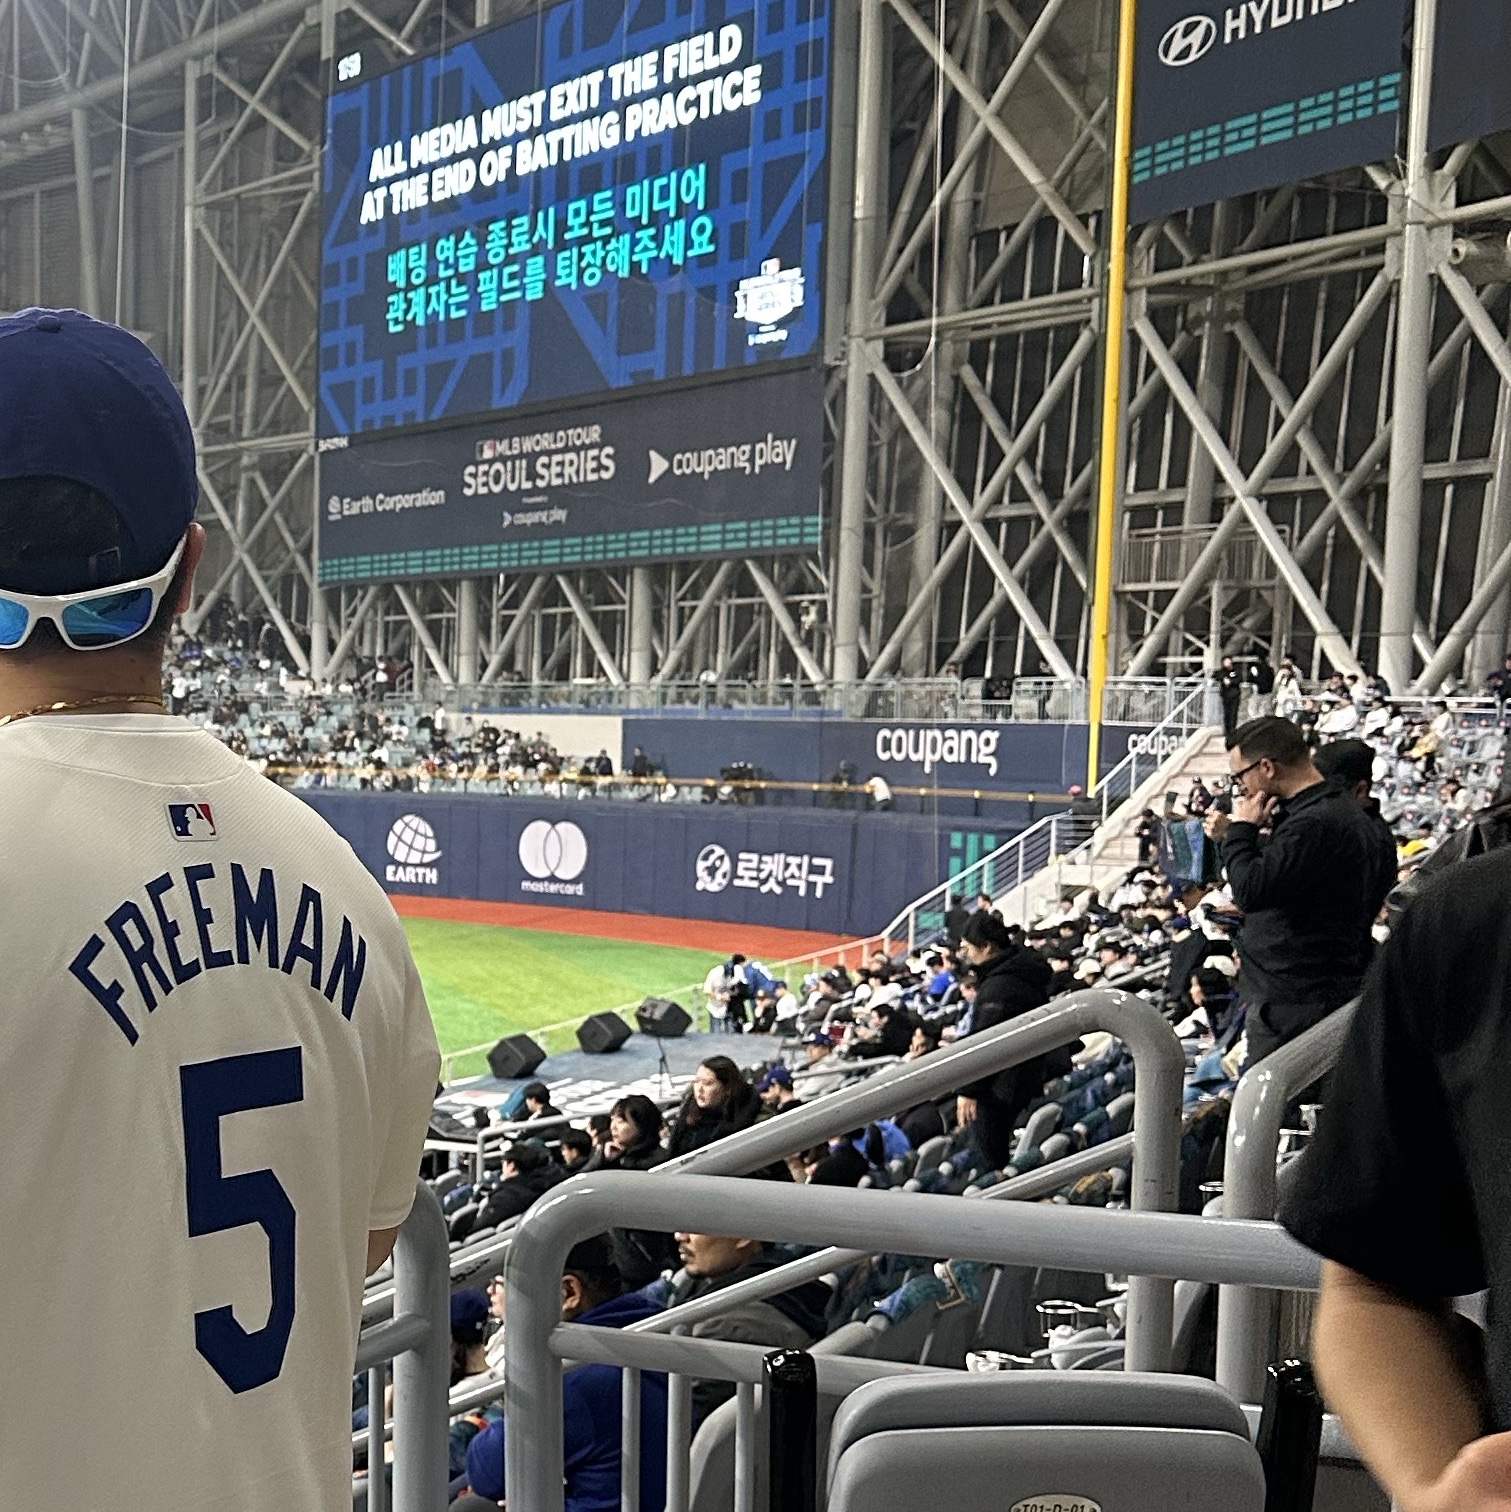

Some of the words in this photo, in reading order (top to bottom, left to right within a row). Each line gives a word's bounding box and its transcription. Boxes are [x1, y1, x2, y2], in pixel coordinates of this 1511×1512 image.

[1223, 0, 1356, 45] HYUN
[368, 141, 408, 183] ALL
[410, 114, 478, 168] MEDIA
[481, 90, 546, 144] MUST
[549, 70, 605, 122] EXIT
[608, 51, 659, 101] THE
[663, 23, 743, 84] FIELD
[360, 186, 388, 225] AT
[389, 173, 430, 214] THE
[431, 158, 477, 202] END
[479, 145, 513, 187] OF
[516, 111, 620, 176] BATTING
[625, 64, 763, 142] PRACTICE
[387, 242, 428, 288] 배팅
[436, 229, 479, 279] 연습
[484, 205, 556, 265] 종료시
[563, 189, 616, 241] 모든
[625, 162, 707, 225] 미디어
[386, 277, 470, 334] 관계자는
[476, 254, 547, 312] 필드를
[554, 214, 716, 290] 퇴장해주세요
[495, 438, 520, 457] MLB
[520, 430, 567, 454] WORLD
[567, 424, 603, 446] TOUR
[672, 443, 752, 481] coupang
[754, 432, 798, 475] play
[462, 460, 533, 497] SEOUL
[534, 446, 617, 486] SERIES
[342, 495, 375, 516] Earth
[375, 486, 445, 512] Corporation
[876, 727, 1001, 777] coupang
[1128, 733, 1187, 756] coupa
[386, 865, 438, 885] EARTH
[521, 879, 584, 896] mastercard
[732, 851, 835, 898] 로켓직구
[68, 862, 367, 1046] FREEMAN
[178, 1046, 304, 1394] 5
